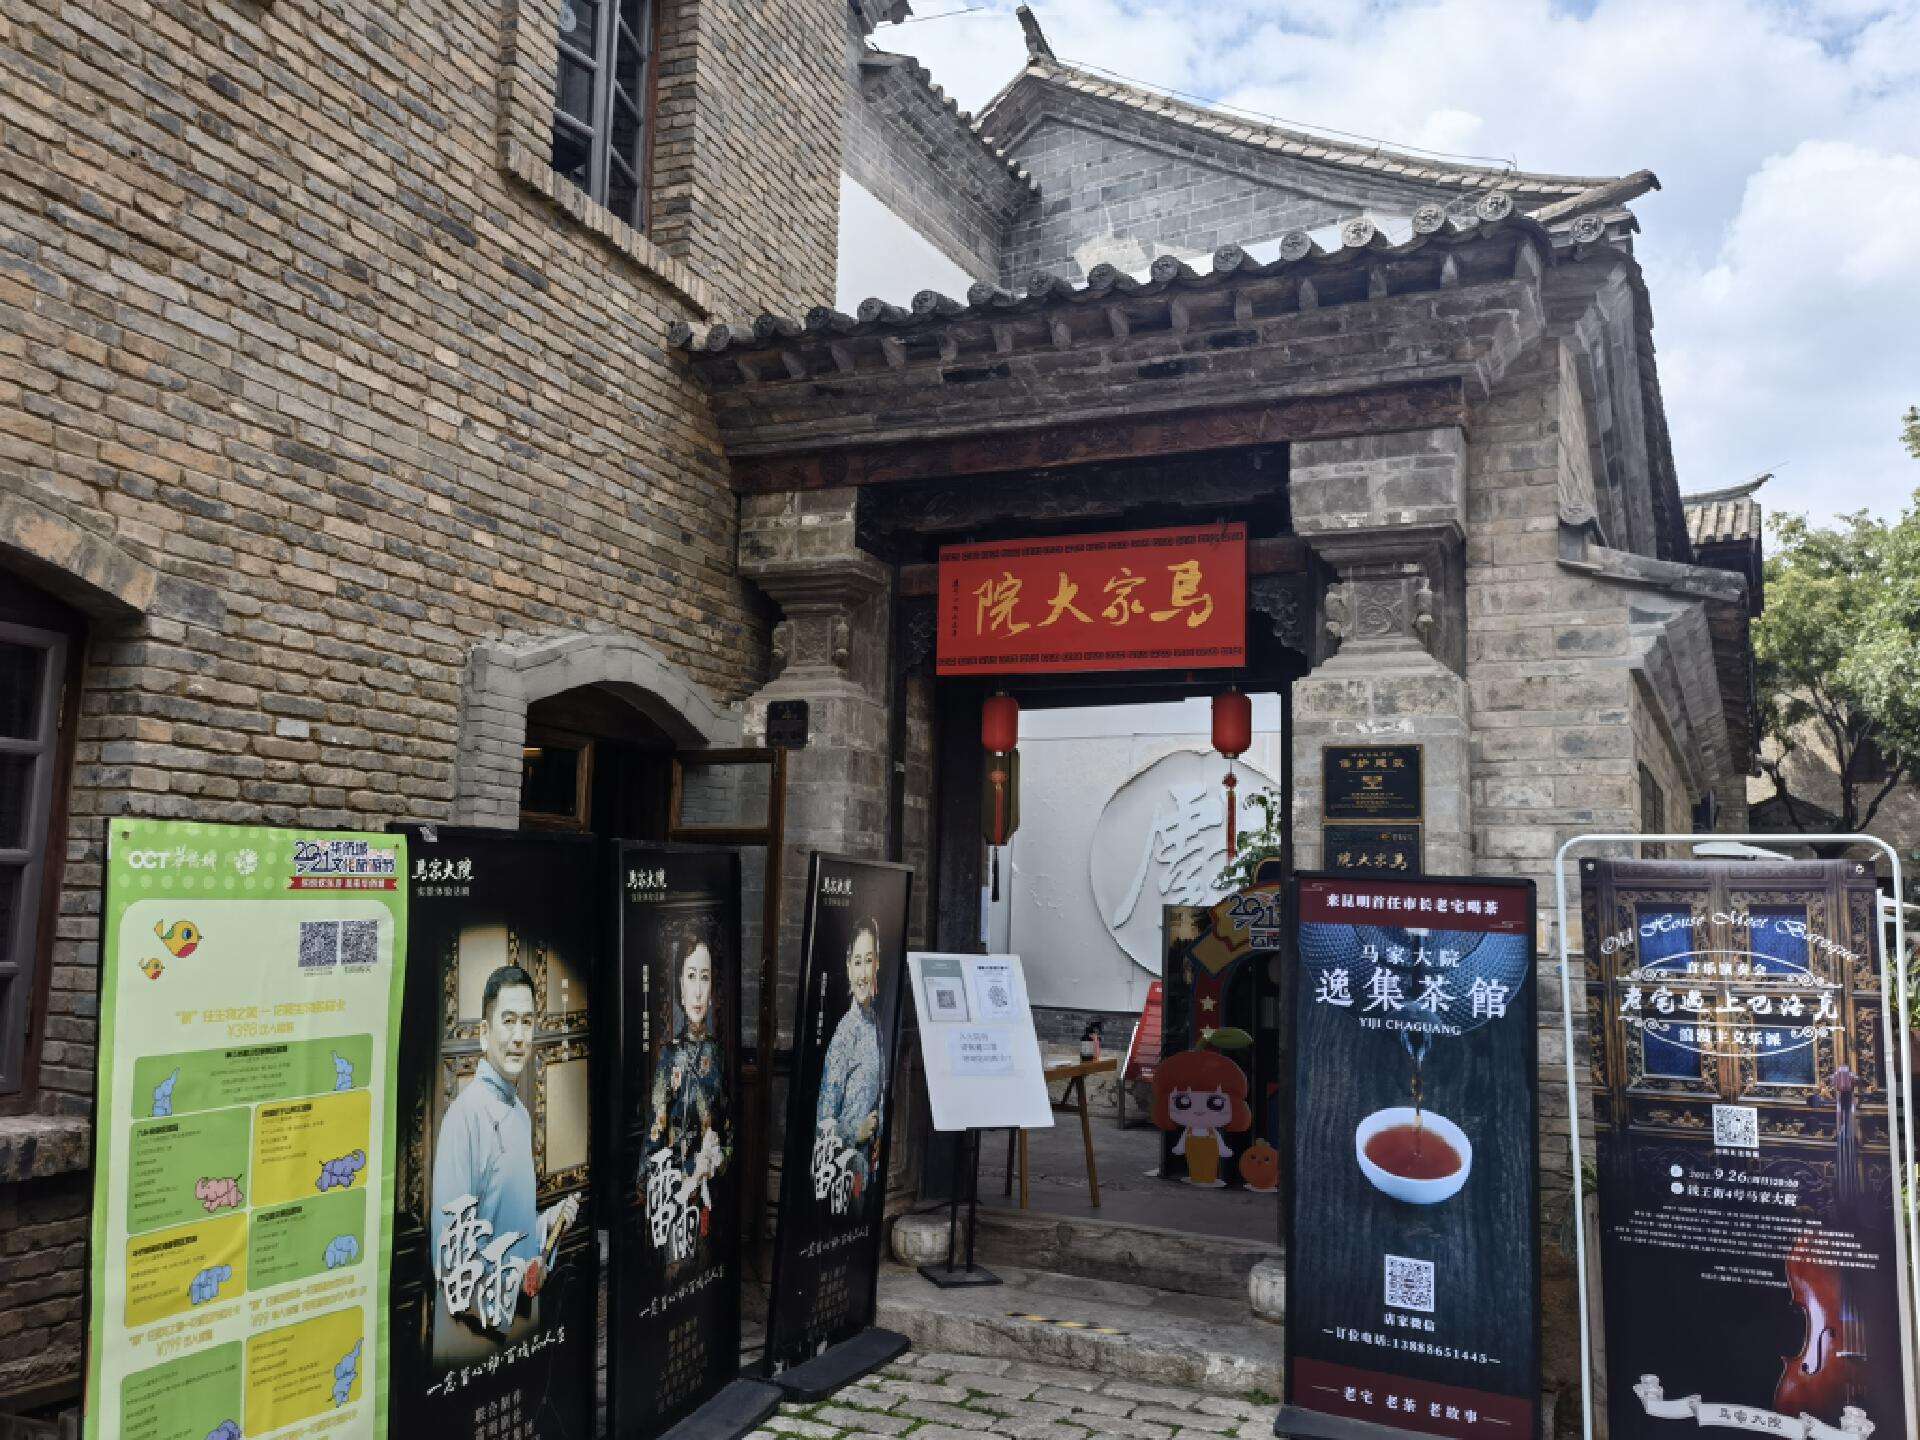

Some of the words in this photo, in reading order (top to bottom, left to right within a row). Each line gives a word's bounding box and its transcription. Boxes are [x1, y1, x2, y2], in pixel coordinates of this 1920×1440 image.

[128, 851, 170, 868] OCT
[1361, 944, 1460, 968] 马家大院
[1358, 1017, 1381, 1028] YIJI
[1344, 1386, 1373, 1404] 老宅
[1386, 1394, 1416, 1413] 老茶
[1430, 1402, 1477, 1423] 老故事
